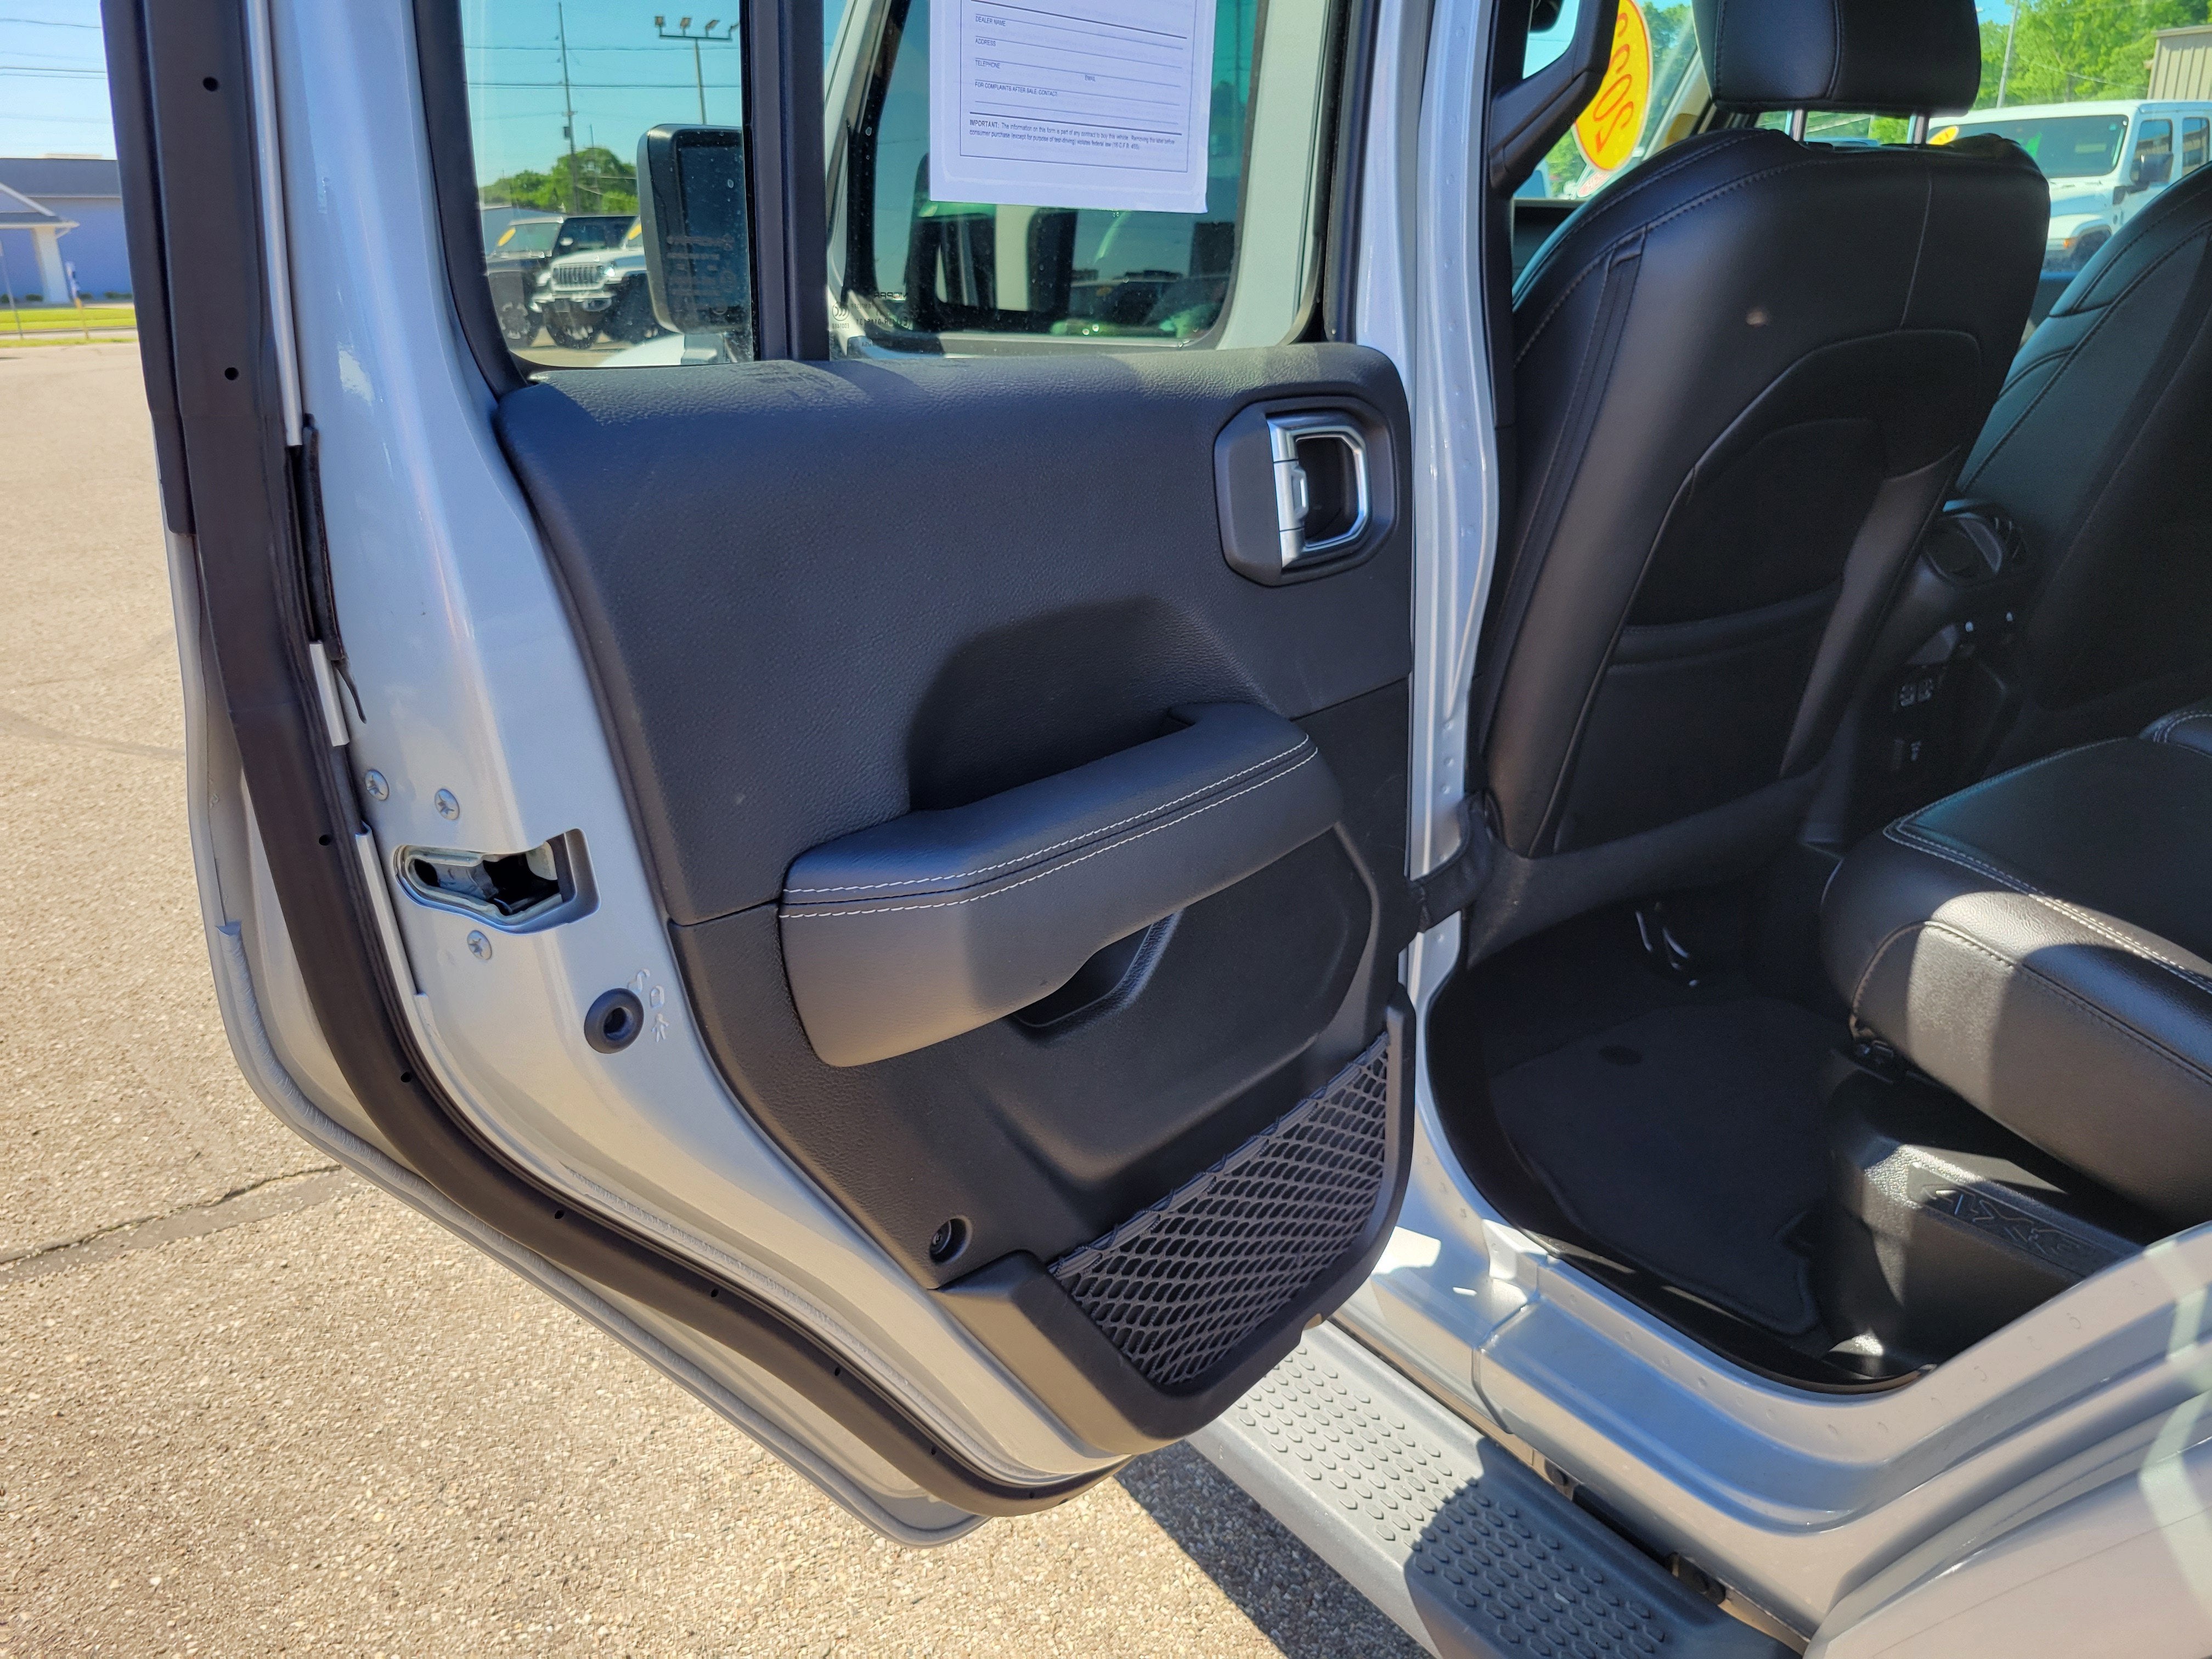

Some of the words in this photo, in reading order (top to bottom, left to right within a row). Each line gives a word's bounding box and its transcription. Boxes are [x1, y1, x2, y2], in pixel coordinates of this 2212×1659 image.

[975, 15, 993, 25] DEALER
[975, 38, 996, 47] ADDRESS
[975, 60, 1001, 69] TELEPHONE
[984, 83, 1012, 92] COMPLAINTS
[969, 119, 1000, 128] IMPORTANT:
[1011, 123, 1032, 132] information
